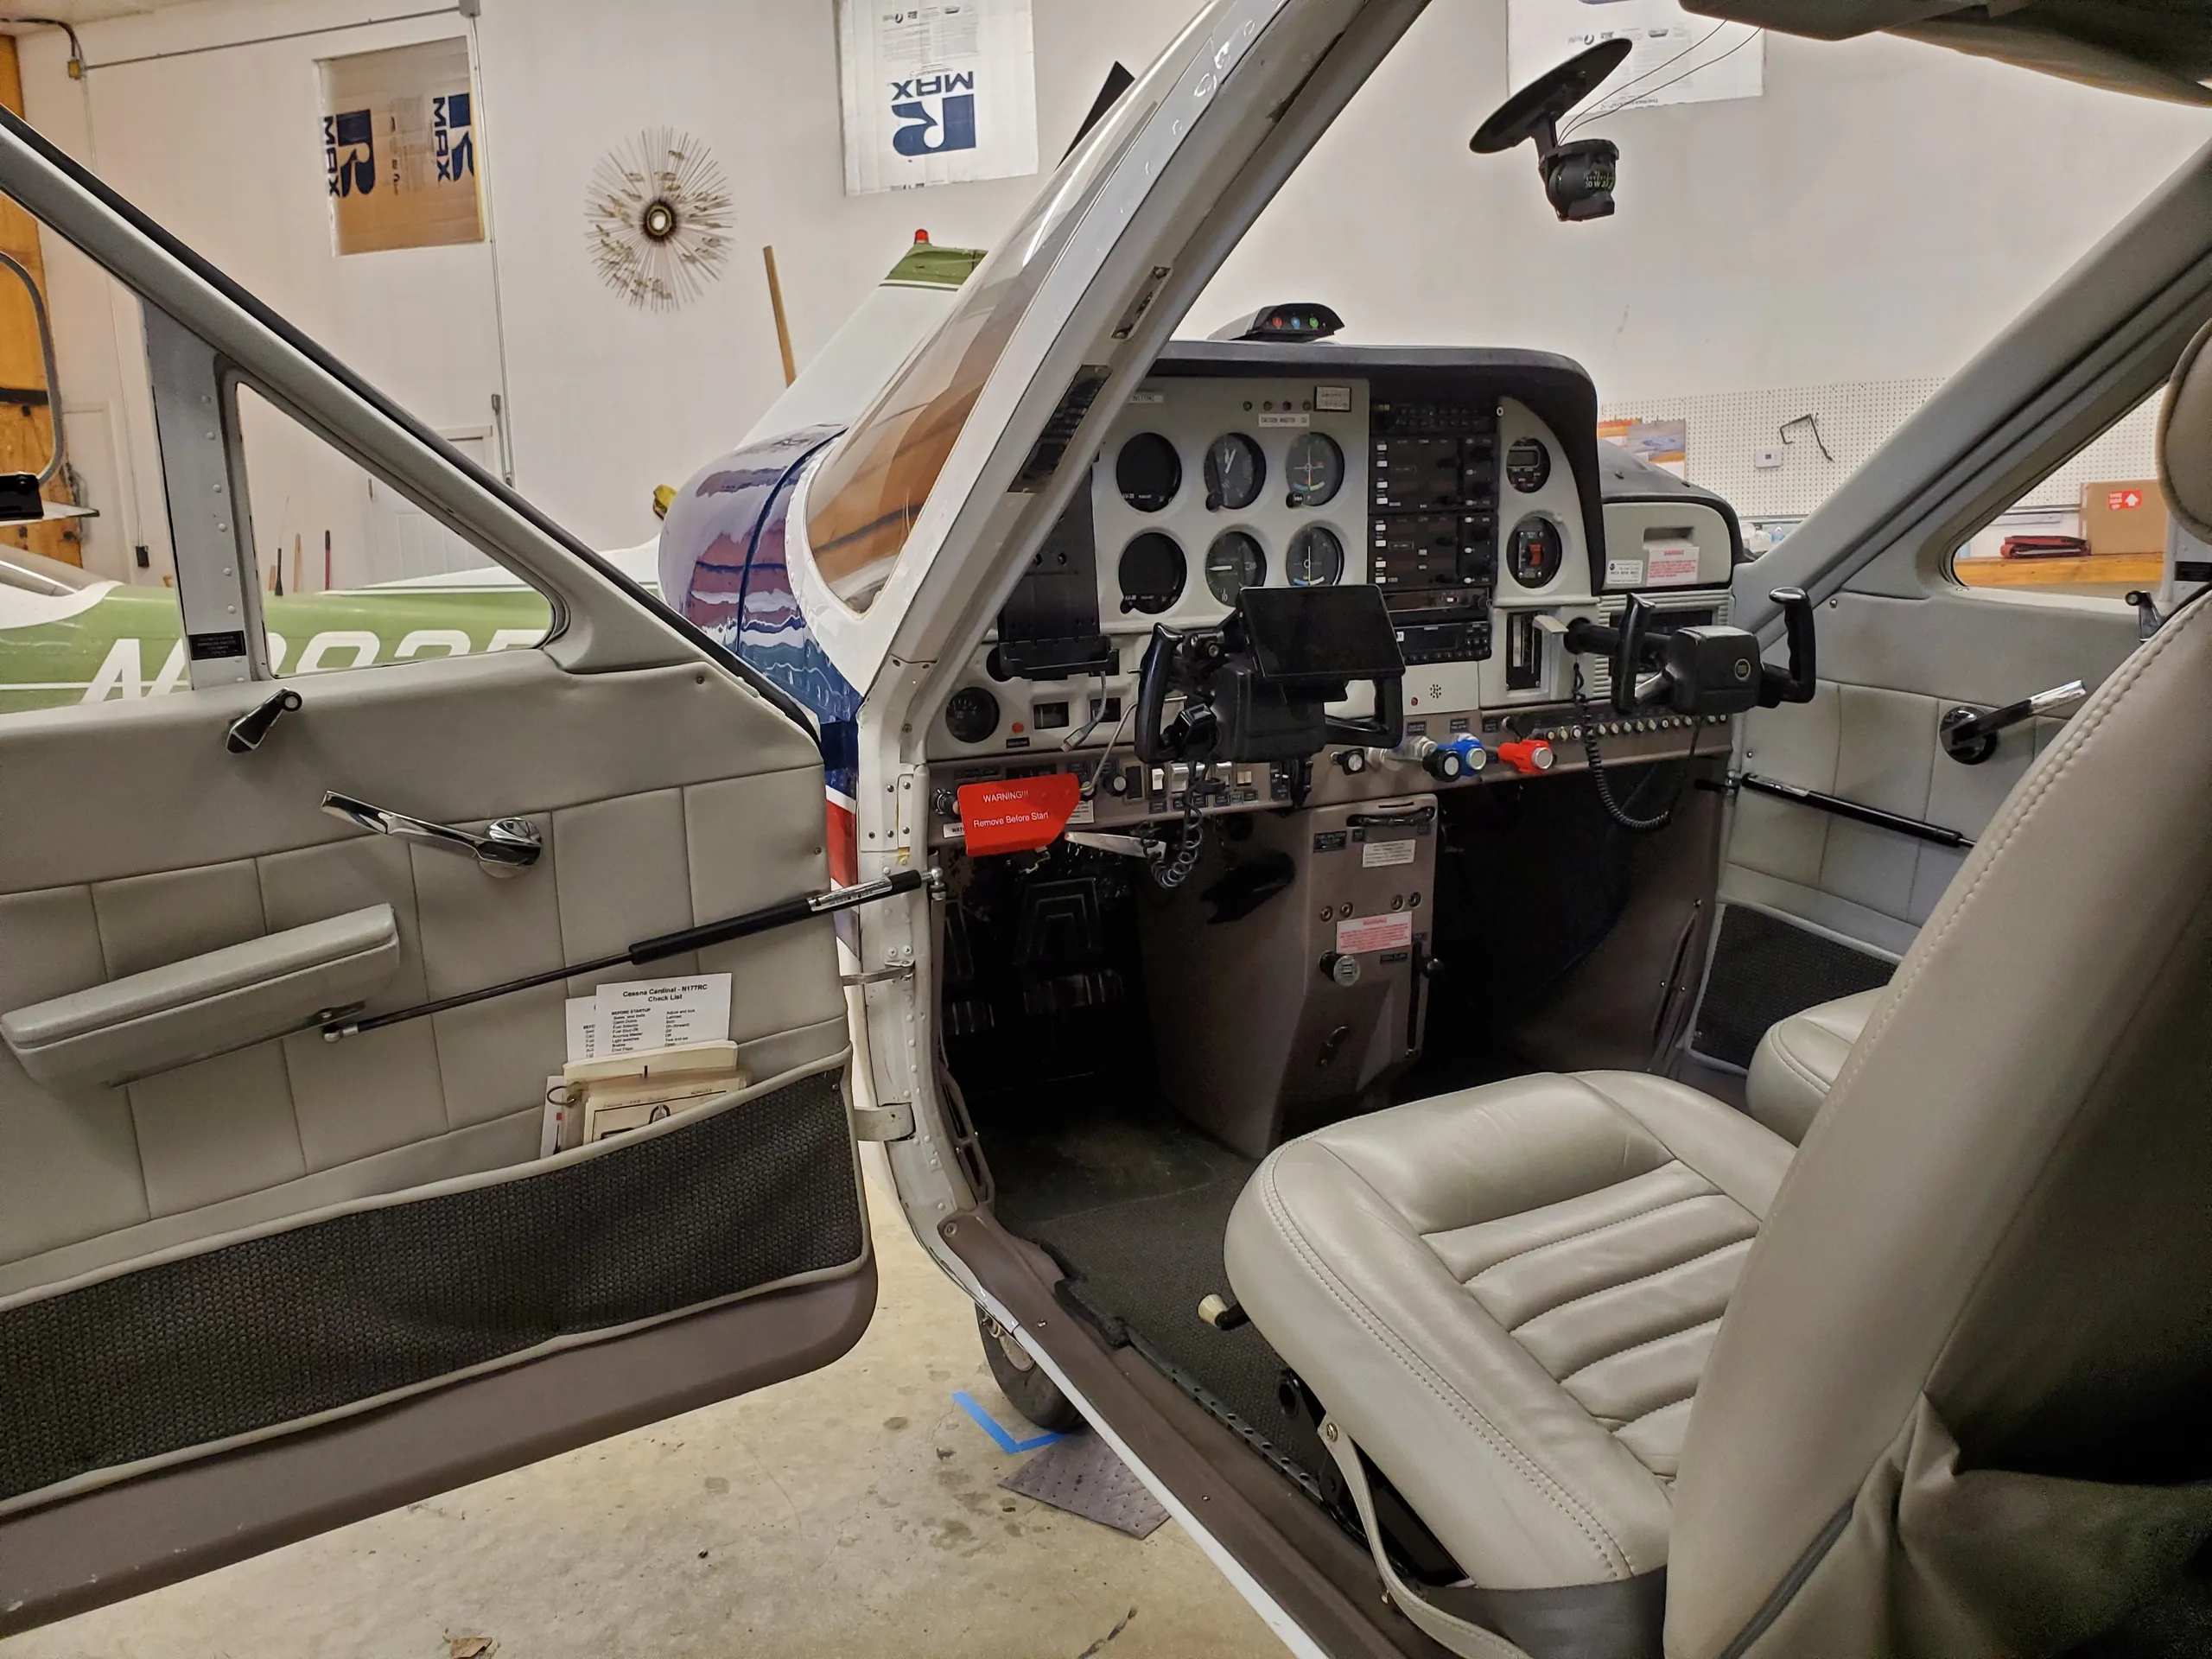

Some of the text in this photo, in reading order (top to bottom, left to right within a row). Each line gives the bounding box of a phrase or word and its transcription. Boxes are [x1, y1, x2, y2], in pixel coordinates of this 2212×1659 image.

[890, 71, 974, 101] MAX
[433, 97, 451, 184] MAX
[323, 115, 340, 198] MAX
[982, 790, 1029, 803] WARNING!!!
[973, 811, 1049, 828] Remove Before Start
[649, 987, 677, 995] Cardinal
